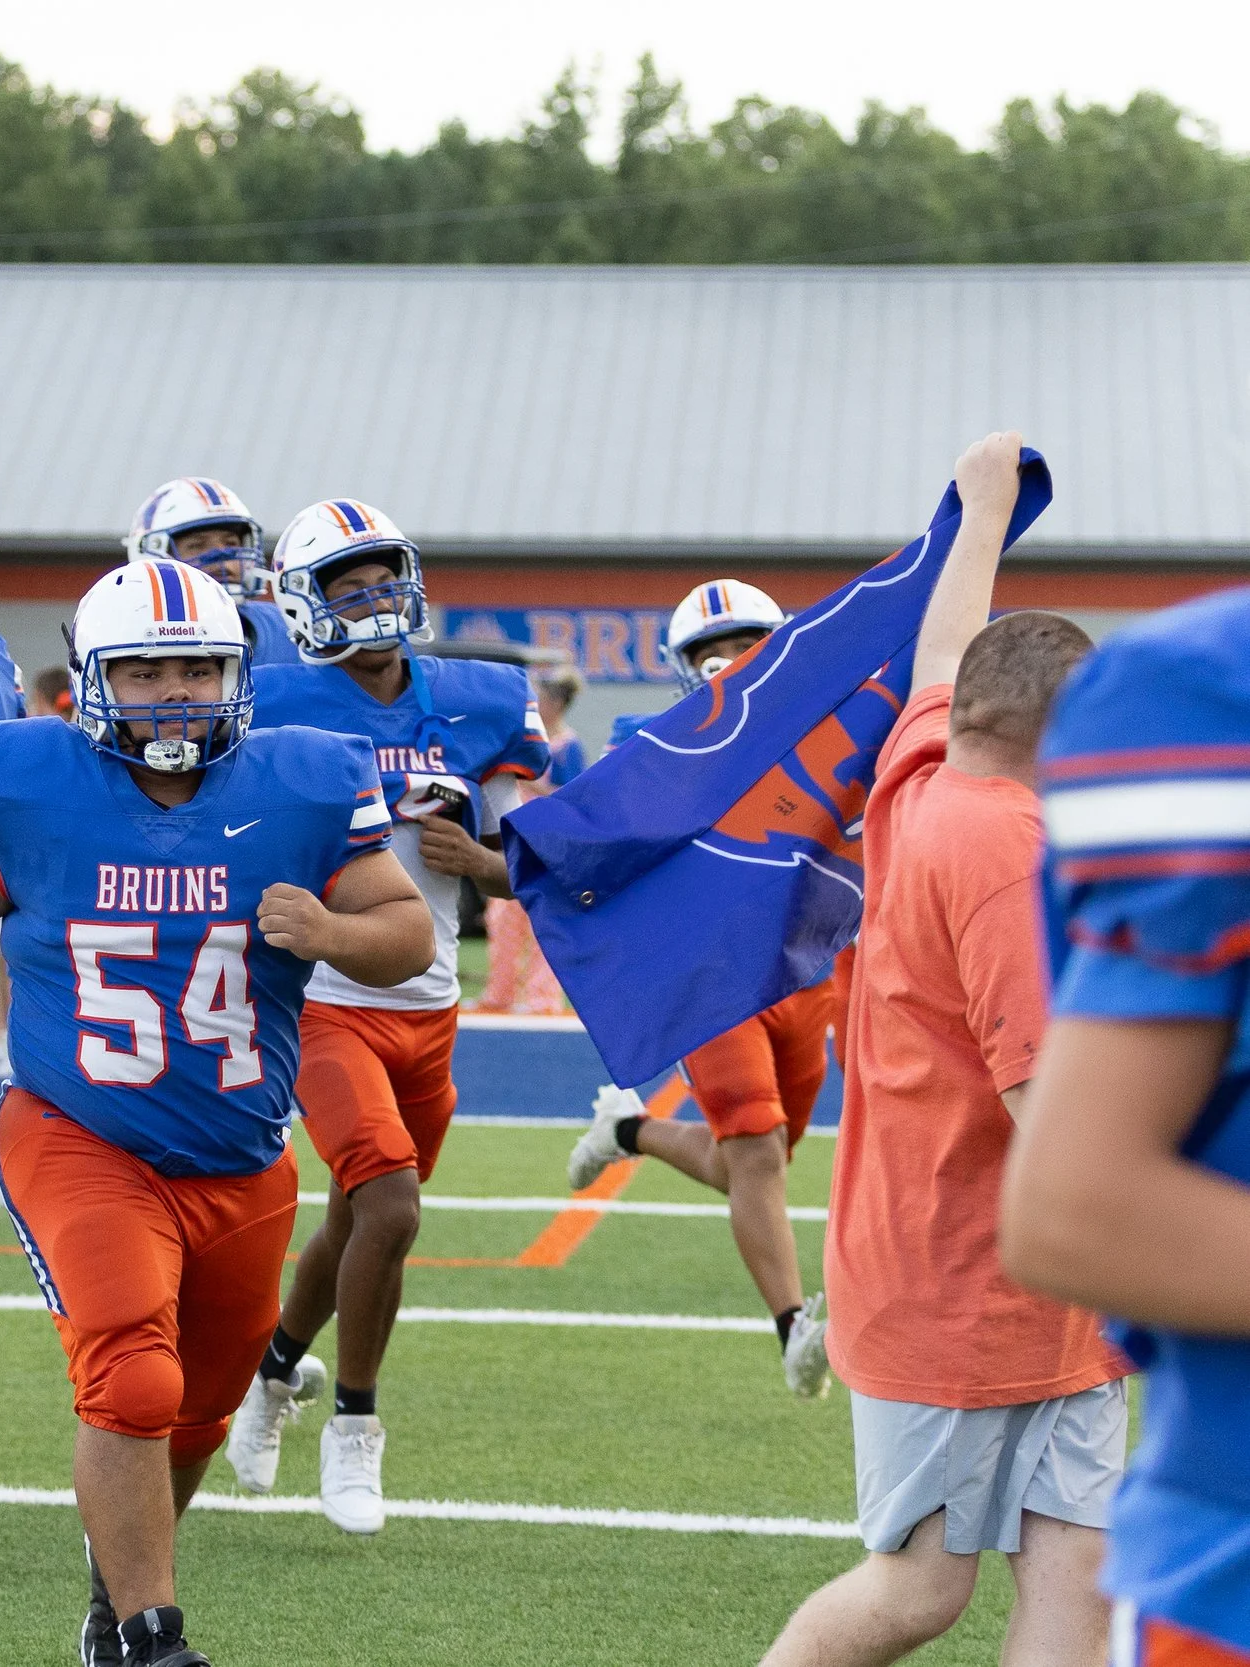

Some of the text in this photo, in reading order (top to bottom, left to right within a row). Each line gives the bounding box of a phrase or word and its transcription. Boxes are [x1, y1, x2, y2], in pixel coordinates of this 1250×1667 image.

[158, 626, 195, 636] Riddell
[96, 863, 228, 913] BRUINS
[66, 918, 265, 1092] 54
